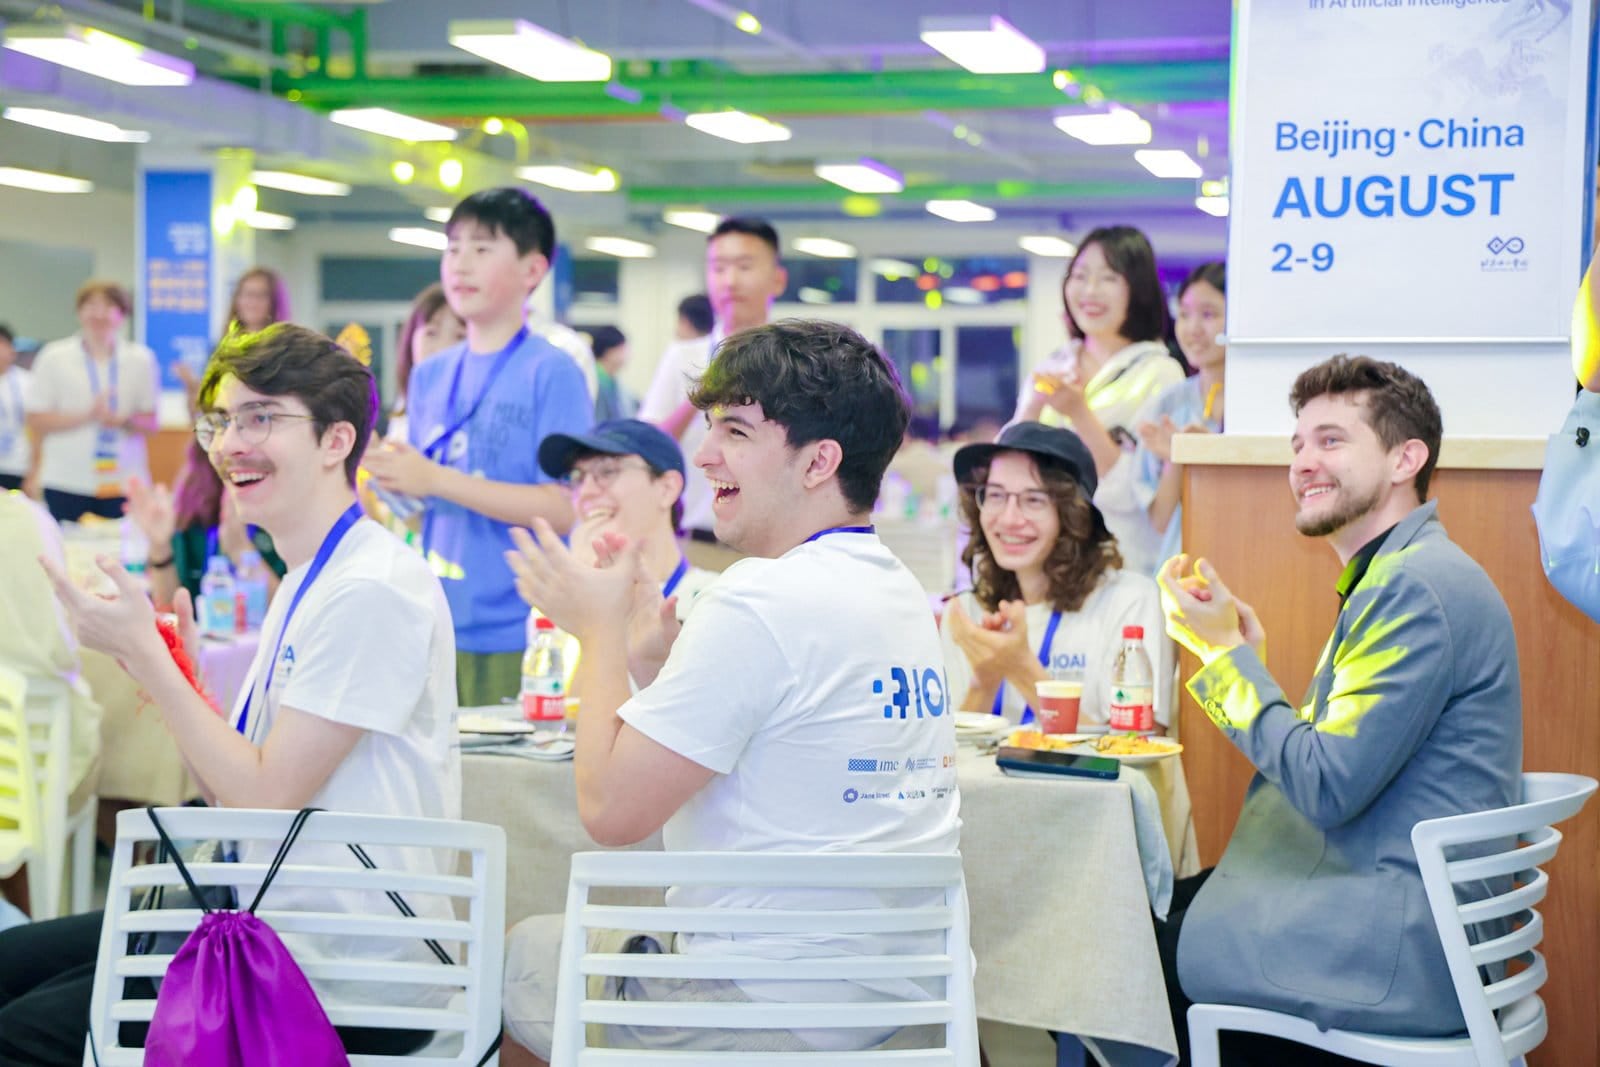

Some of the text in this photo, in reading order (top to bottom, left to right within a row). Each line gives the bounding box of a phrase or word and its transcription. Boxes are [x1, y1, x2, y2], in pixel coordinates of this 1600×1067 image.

[1407, 0, 1511, 8] Intellig
[1275, 120, 1396, 158] Beijing
[1418, 117, 1525, 149] China
[1272, 173, 1515, 218] AUGUST
[1271, 242, 1335, 272] 2-9
[912, 667, 951, 719] IO
